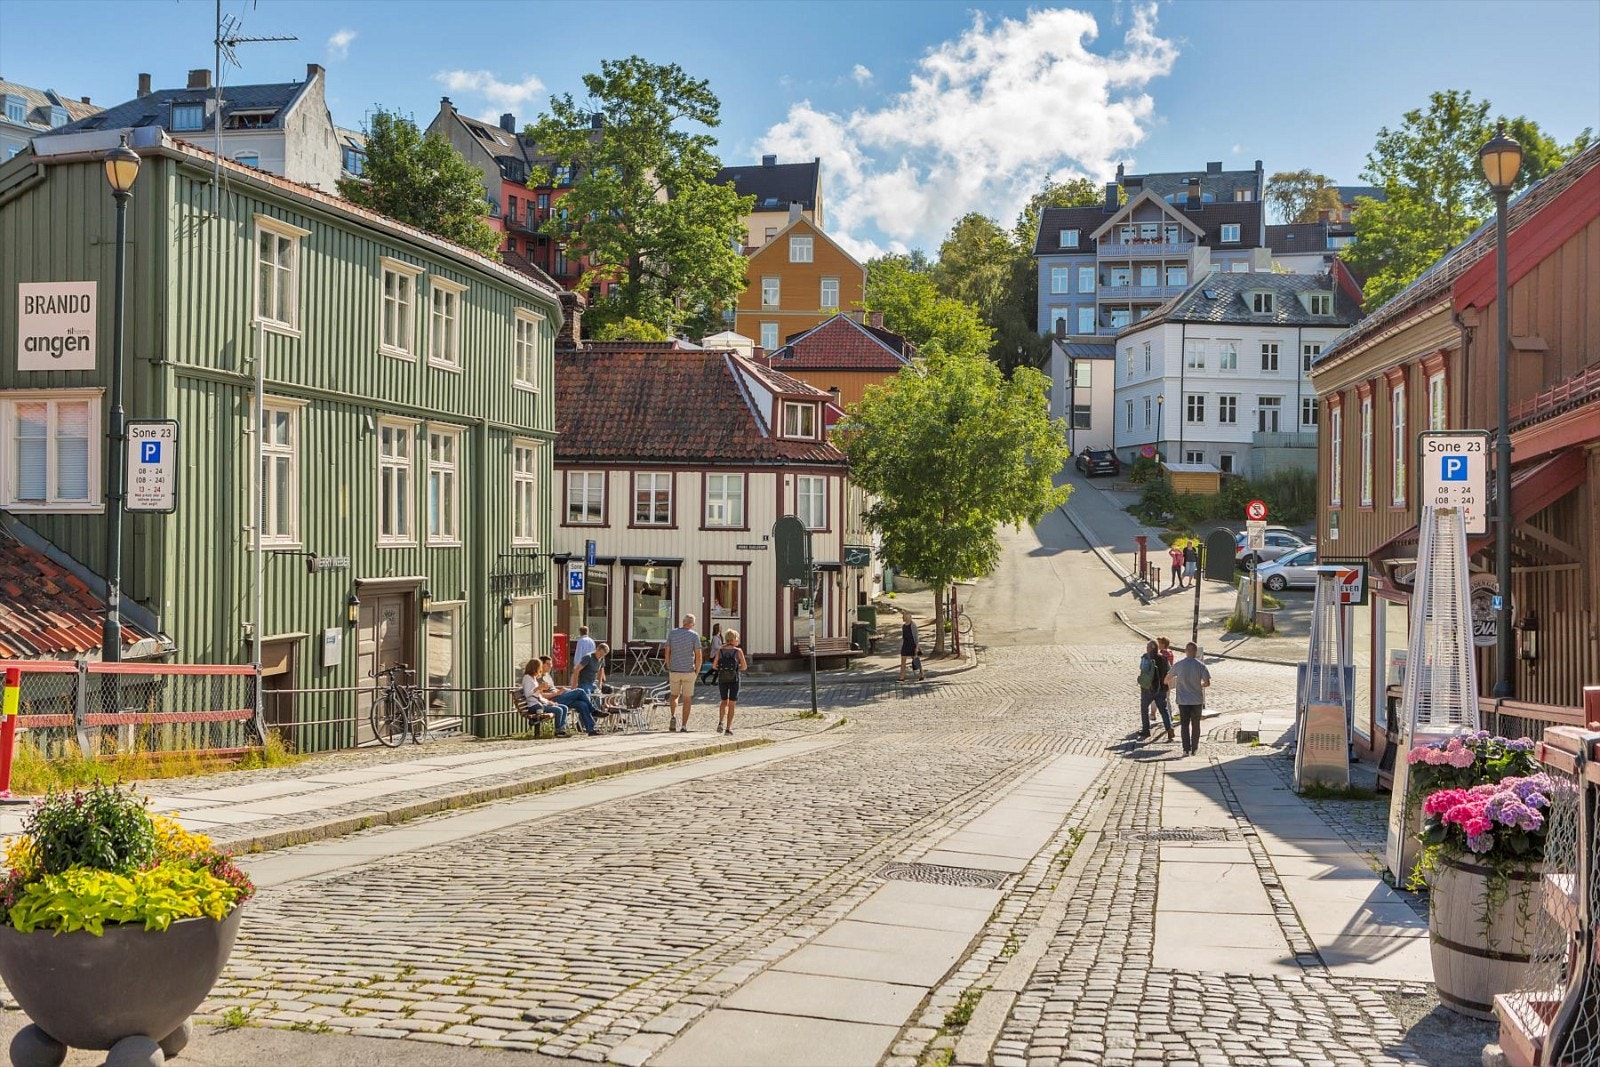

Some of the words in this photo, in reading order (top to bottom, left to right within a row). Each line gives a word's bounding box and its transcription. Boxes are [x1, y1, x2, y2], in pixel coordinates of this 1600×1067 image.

[24, 294, 90, 315] BRANDO
[24, 335, 90, 359] angen
[132, 427, 157, 438] Sone
[160, 428, 171, 438] 23
[145, 443, 156, 461] P
[1428, 440, 1461, 452] Sone
[1467, 442, 1481, 452] 23
[1447, 459, 1461, 478] P
[1438, 486, 1449, 494] 08
[1461, 486, 1471, 494] 24
[1435, 497, 1449, 505] (08
[1461, 497, 1475, 505] 24)
